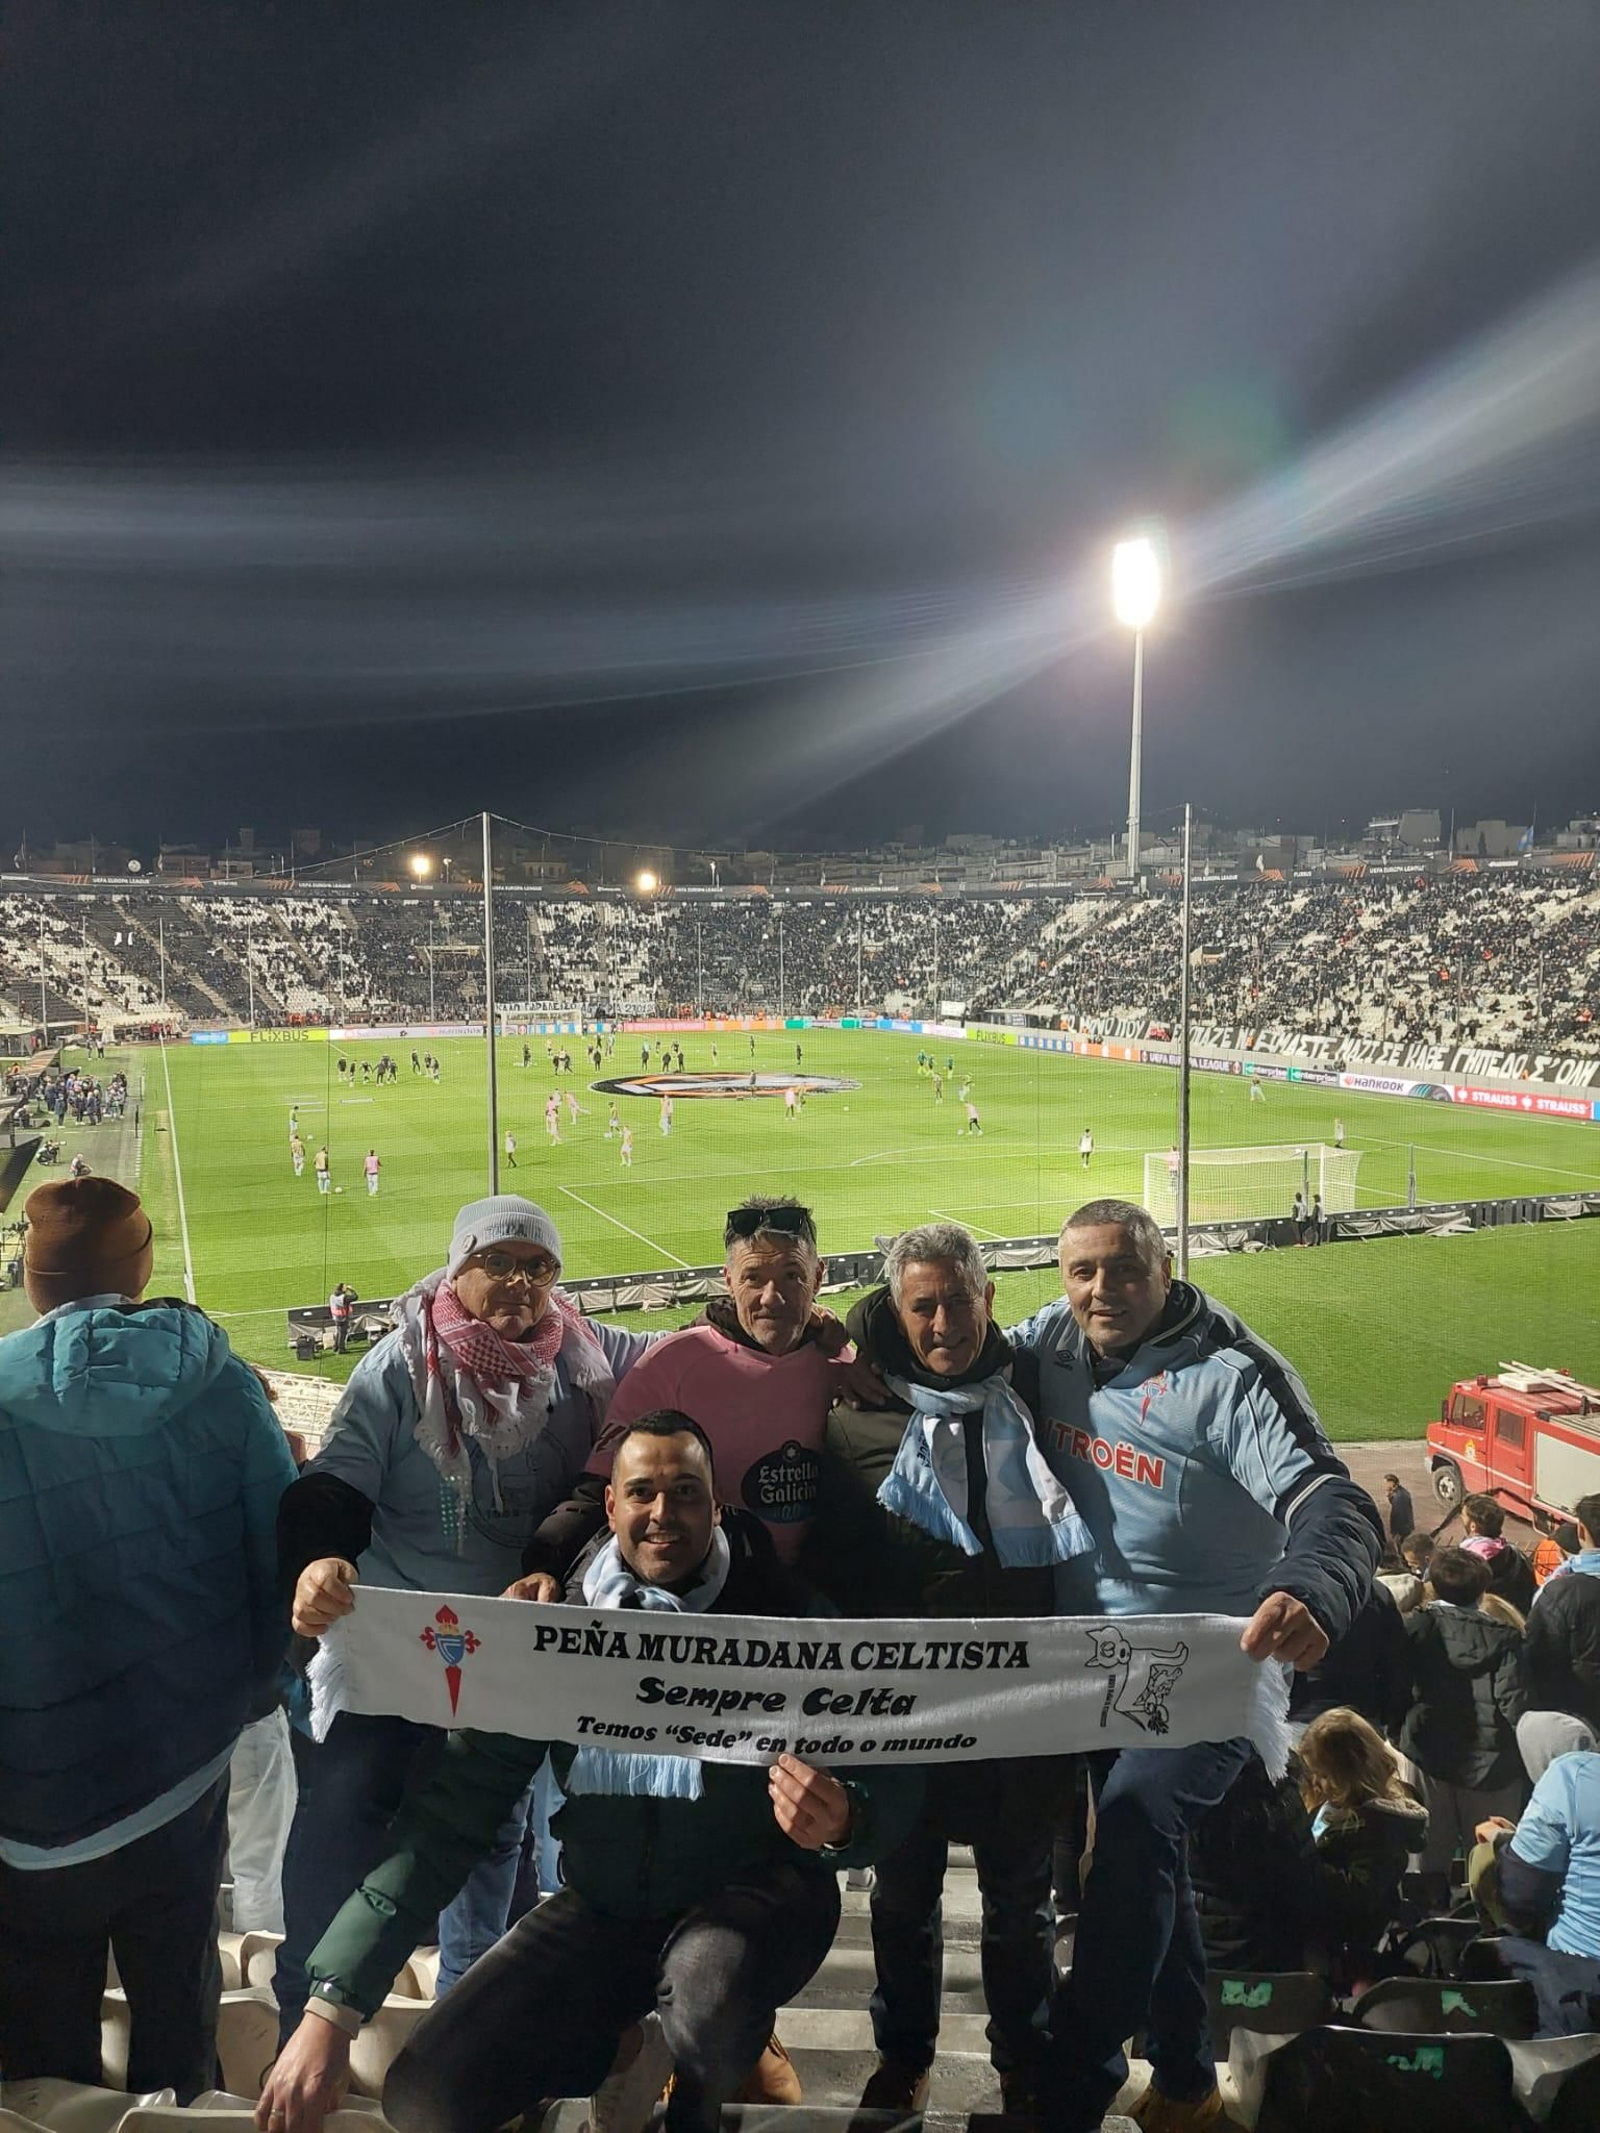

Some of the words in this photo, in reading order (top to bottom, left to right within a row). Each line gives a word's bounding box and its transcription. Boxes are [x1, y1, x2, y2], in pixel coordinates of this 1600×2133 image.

[1149, 1052, 1169, 1066] UEFA
[1200, 1057, 1231, 1072] LEAGUE
[1375, 1041, 1406, 1067] ΣΕ
[1403, 1043, 1450, 1071] ΚΑΘΕ
[1450, 1047, 1529, 1079] ΓΗΠΕΔΟ
[1472, 1091, 1518, 1106] STRAUSS
[1536, 1098, 1586, 1114] STRAUSS
[533, 1620, 631, 1659] PEÑA
[638, 1633, 844, 1671] MURADANA
[850, 1640, 1030, 1671] CELTISTA
[635, 1676, 786, 1717] Sempre
[801, 1687, 918, 1718] Celta
[575, 1715, 658, 1742] Temos
[755, 1734, 788, 1753] en
[794, 1732, 854, 1755] todo
[859, 1737, 877, 1753] o
[880, 1733, 978, 1753] mundo
